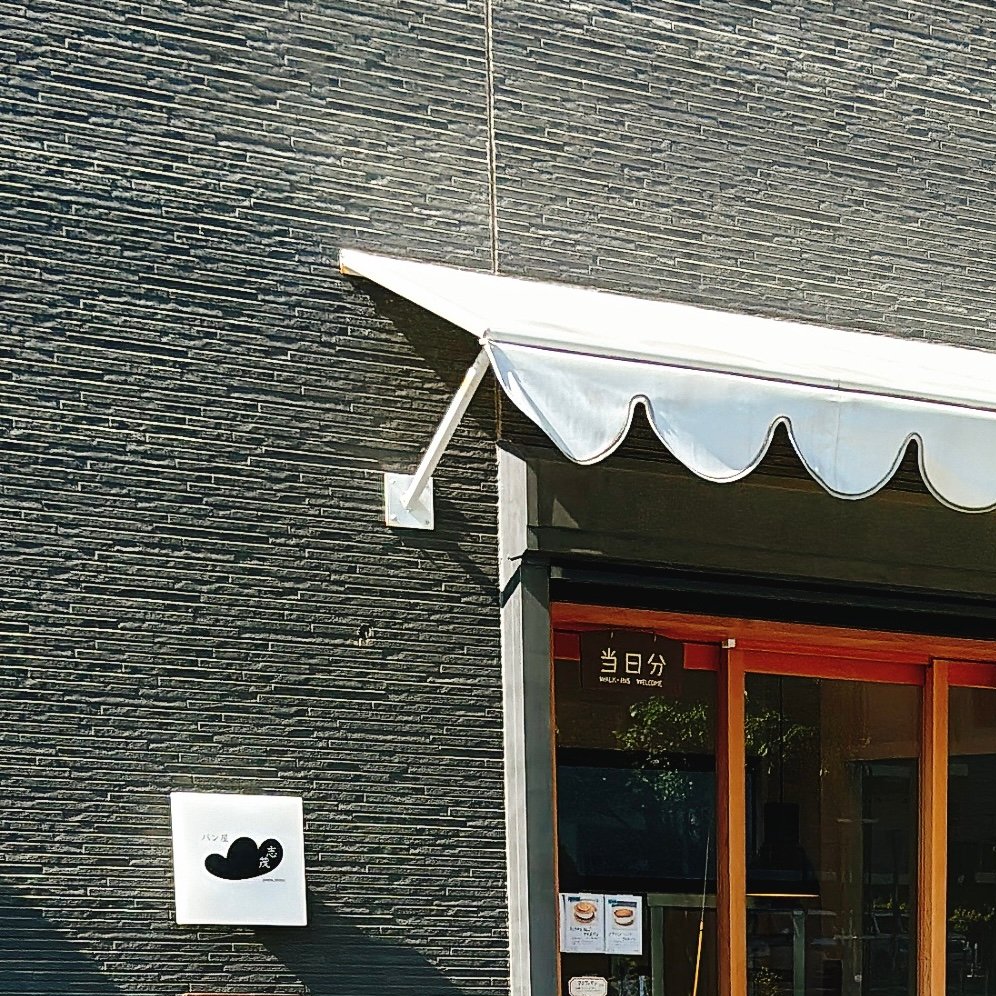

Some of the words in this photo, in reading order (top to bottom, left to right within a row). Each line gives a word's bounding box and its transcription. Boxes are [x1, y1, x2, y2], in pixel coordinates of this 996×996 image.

[600, 647, 667, 676] 当日分
[636, 678, 663, 688] WELCOME
[201, 833, 229, 843] パン屋
[258, 845, 278, 869] 志茂
